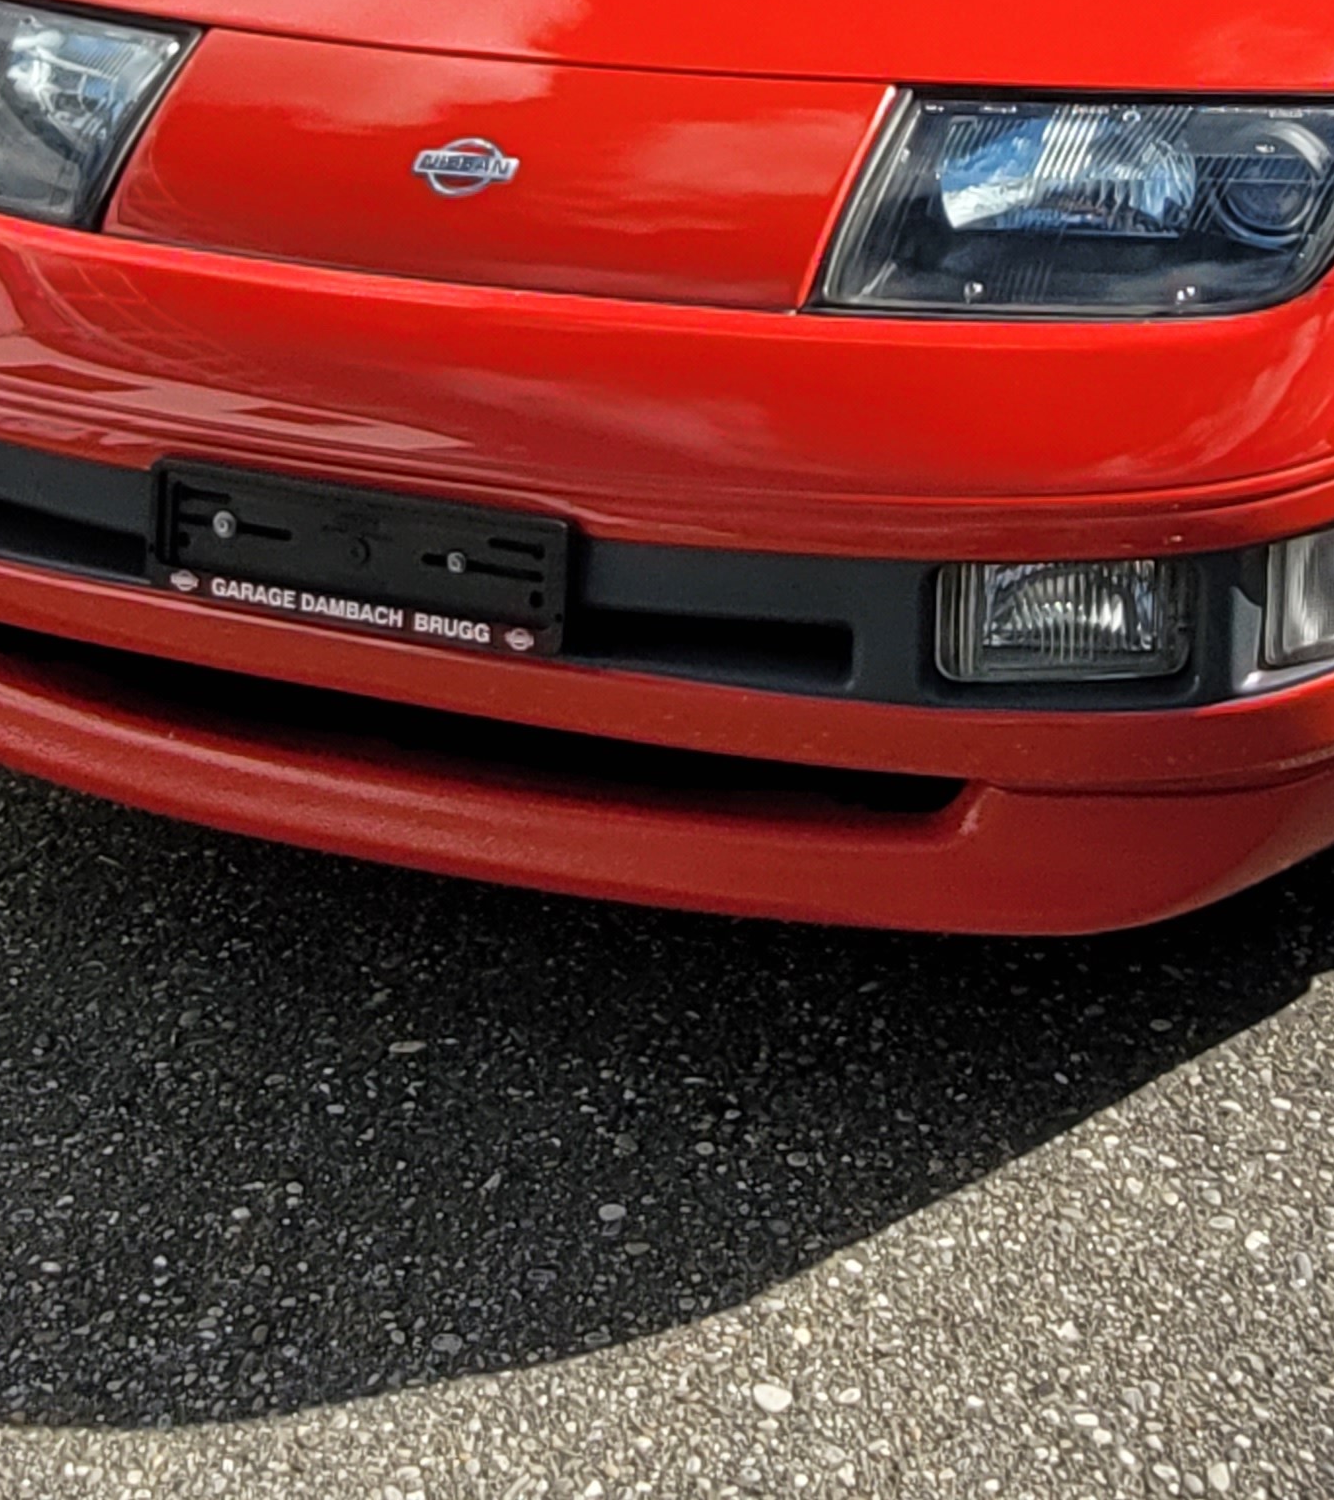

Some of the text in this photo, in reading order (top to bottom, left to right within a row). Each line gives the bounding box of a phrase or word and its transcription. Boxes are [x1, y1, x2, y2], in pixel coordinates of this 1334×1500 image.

[420, 154, 511, 175] NISSAN
[211, 577, 491, 644] GARAGE DAMBACH BRUGG
